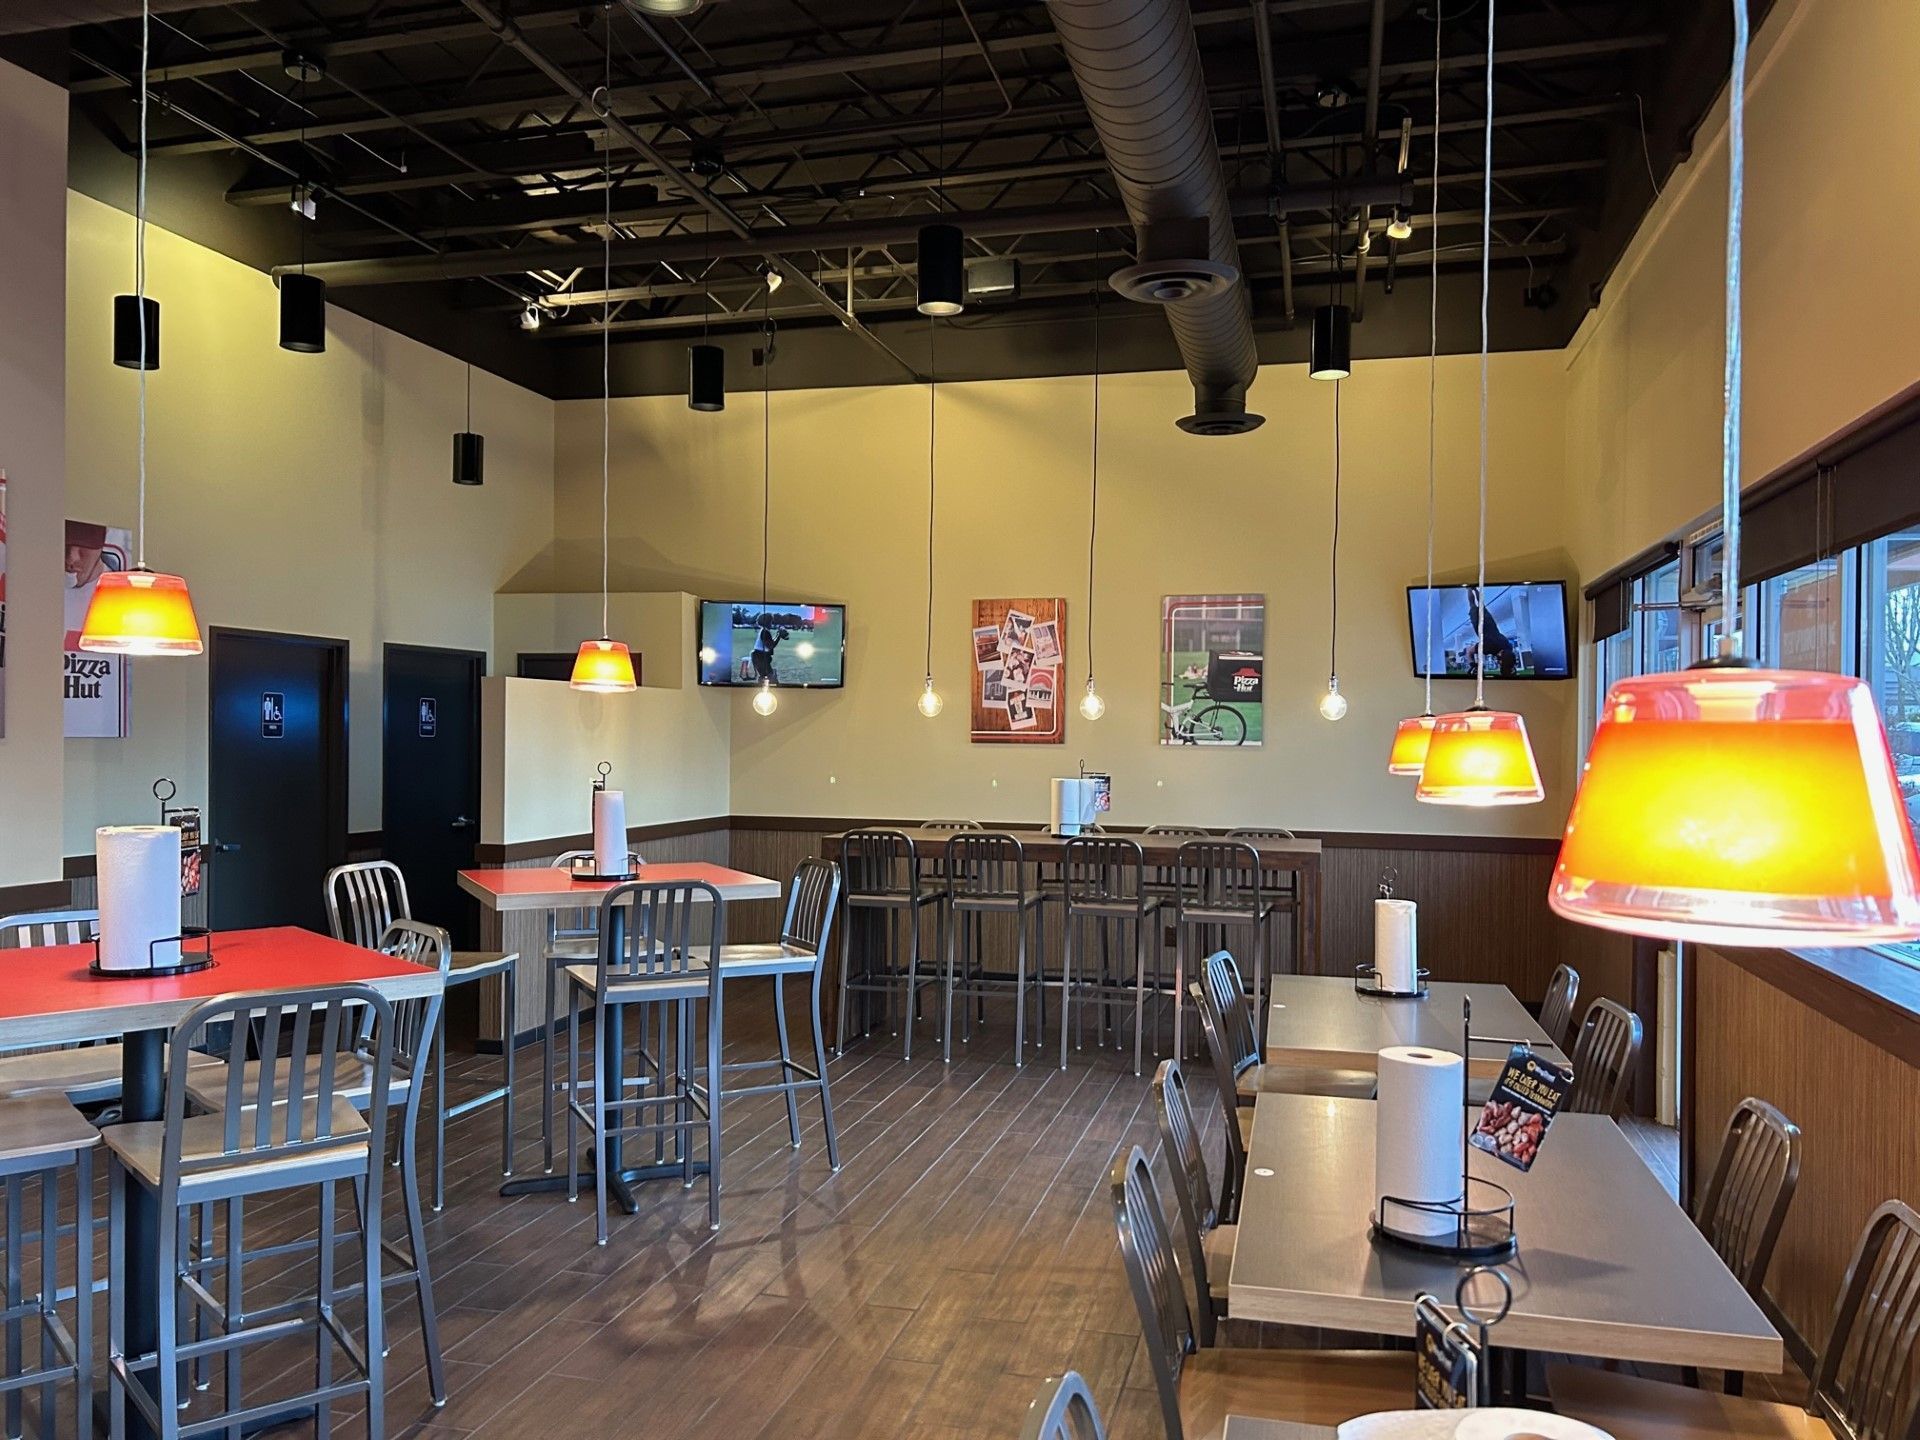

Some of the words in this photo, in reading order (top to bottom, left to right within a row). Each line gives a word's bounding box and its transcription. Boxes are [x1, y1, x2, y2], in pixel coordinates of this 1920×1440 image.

[64, 675, 102, 699] Hut
[1233, 675, 1259, 686] Pizza
[1507, 1067, 1521, 1080] WE
